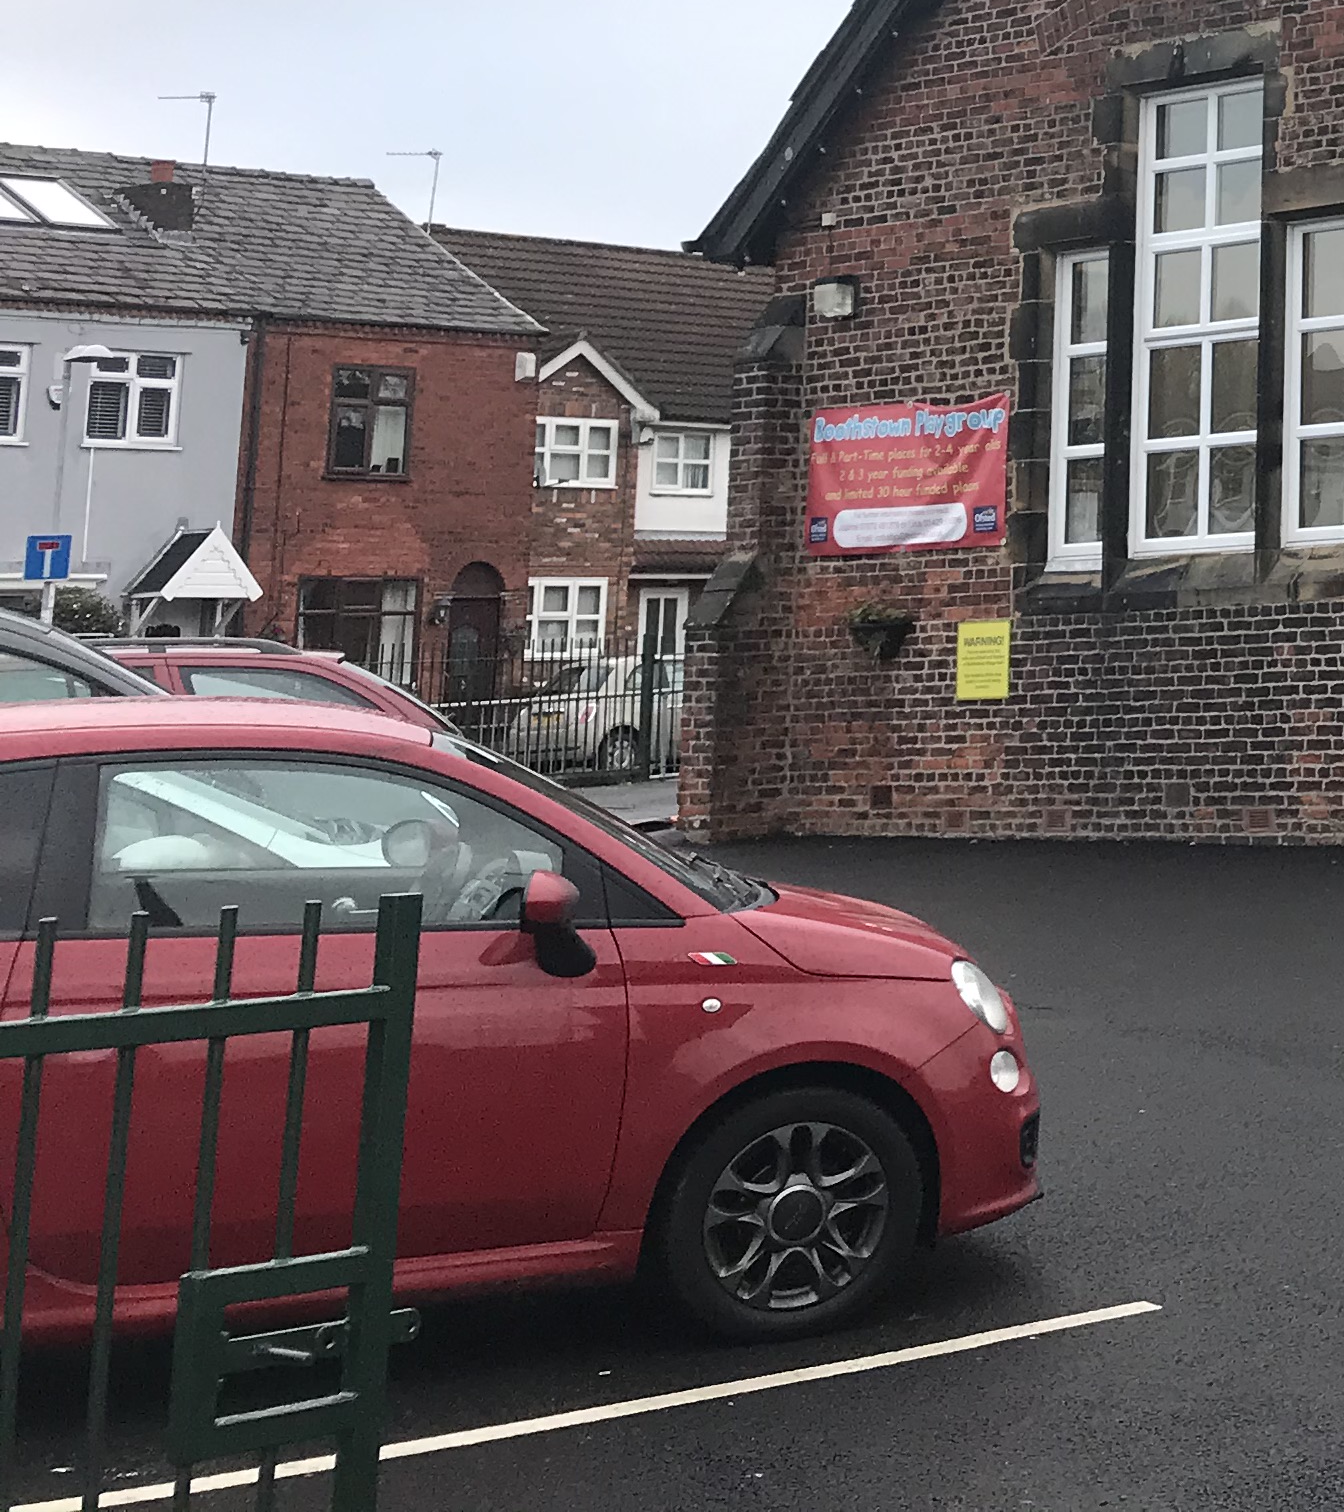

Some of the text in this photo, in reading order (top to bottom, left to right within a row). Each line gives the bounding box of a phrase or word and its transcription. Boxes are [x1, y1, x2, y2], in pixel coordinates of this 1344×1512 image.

[814, 408, 1006, 443] Boothstown Playgroup
[838, 449, 885, 463] Part-Time
[935, 442, 954, 457] 2-4
[839, 469, 846, 482] 2
[858, 469, 864, 481] 3
[866, 470, 889, 484] year
[877, 485, 890, 498] 30
